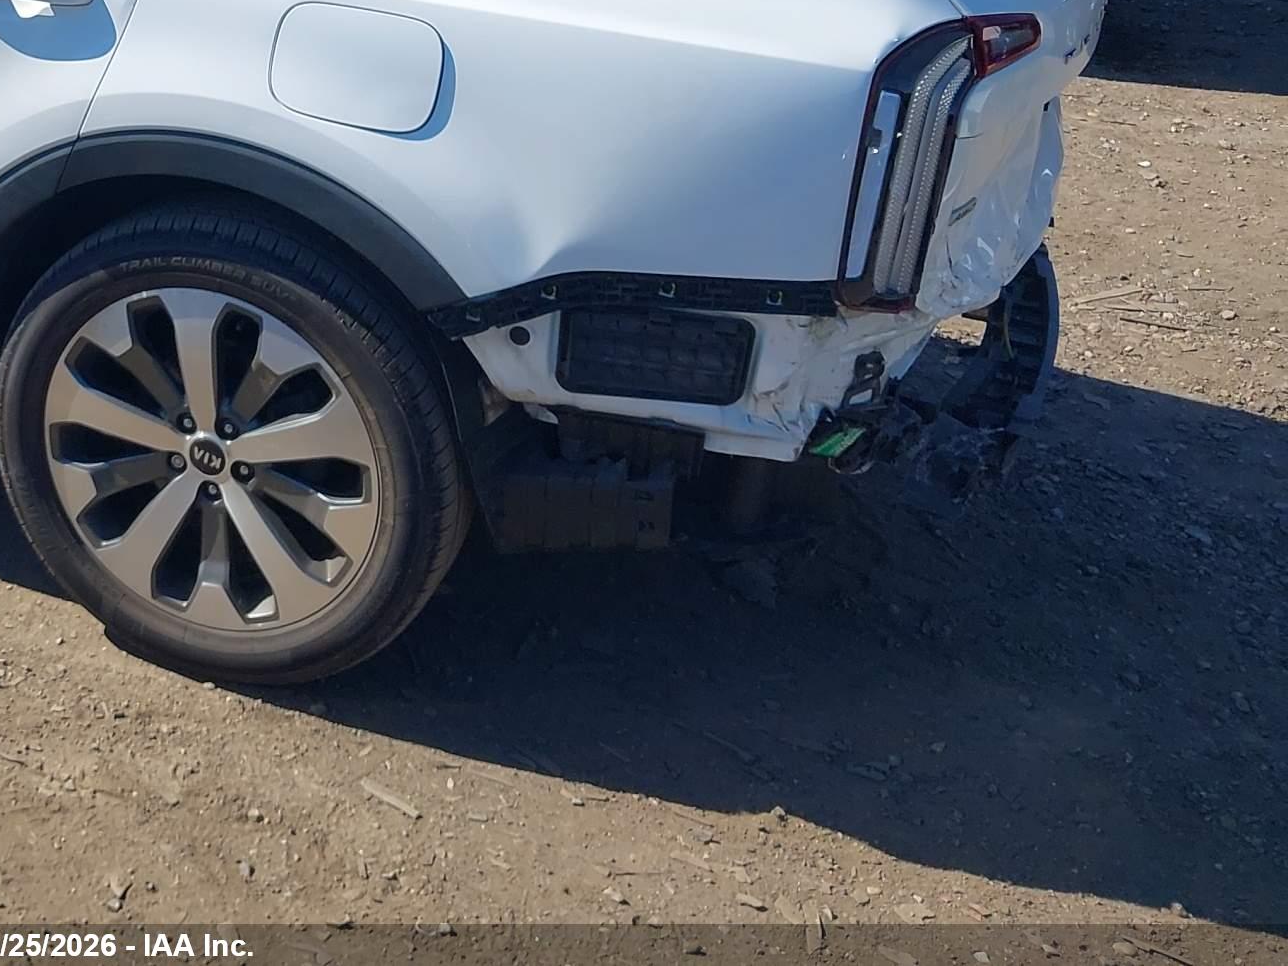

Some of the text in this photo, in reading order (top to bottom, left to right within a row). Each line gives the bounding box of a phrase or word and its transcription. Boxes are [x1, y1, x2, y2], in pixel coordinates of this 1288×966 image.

[119, 256, 167, 273] TRAIL
[169, 256, 248, 282] CLIMBER
[193, 445, 222, 470] KIA
